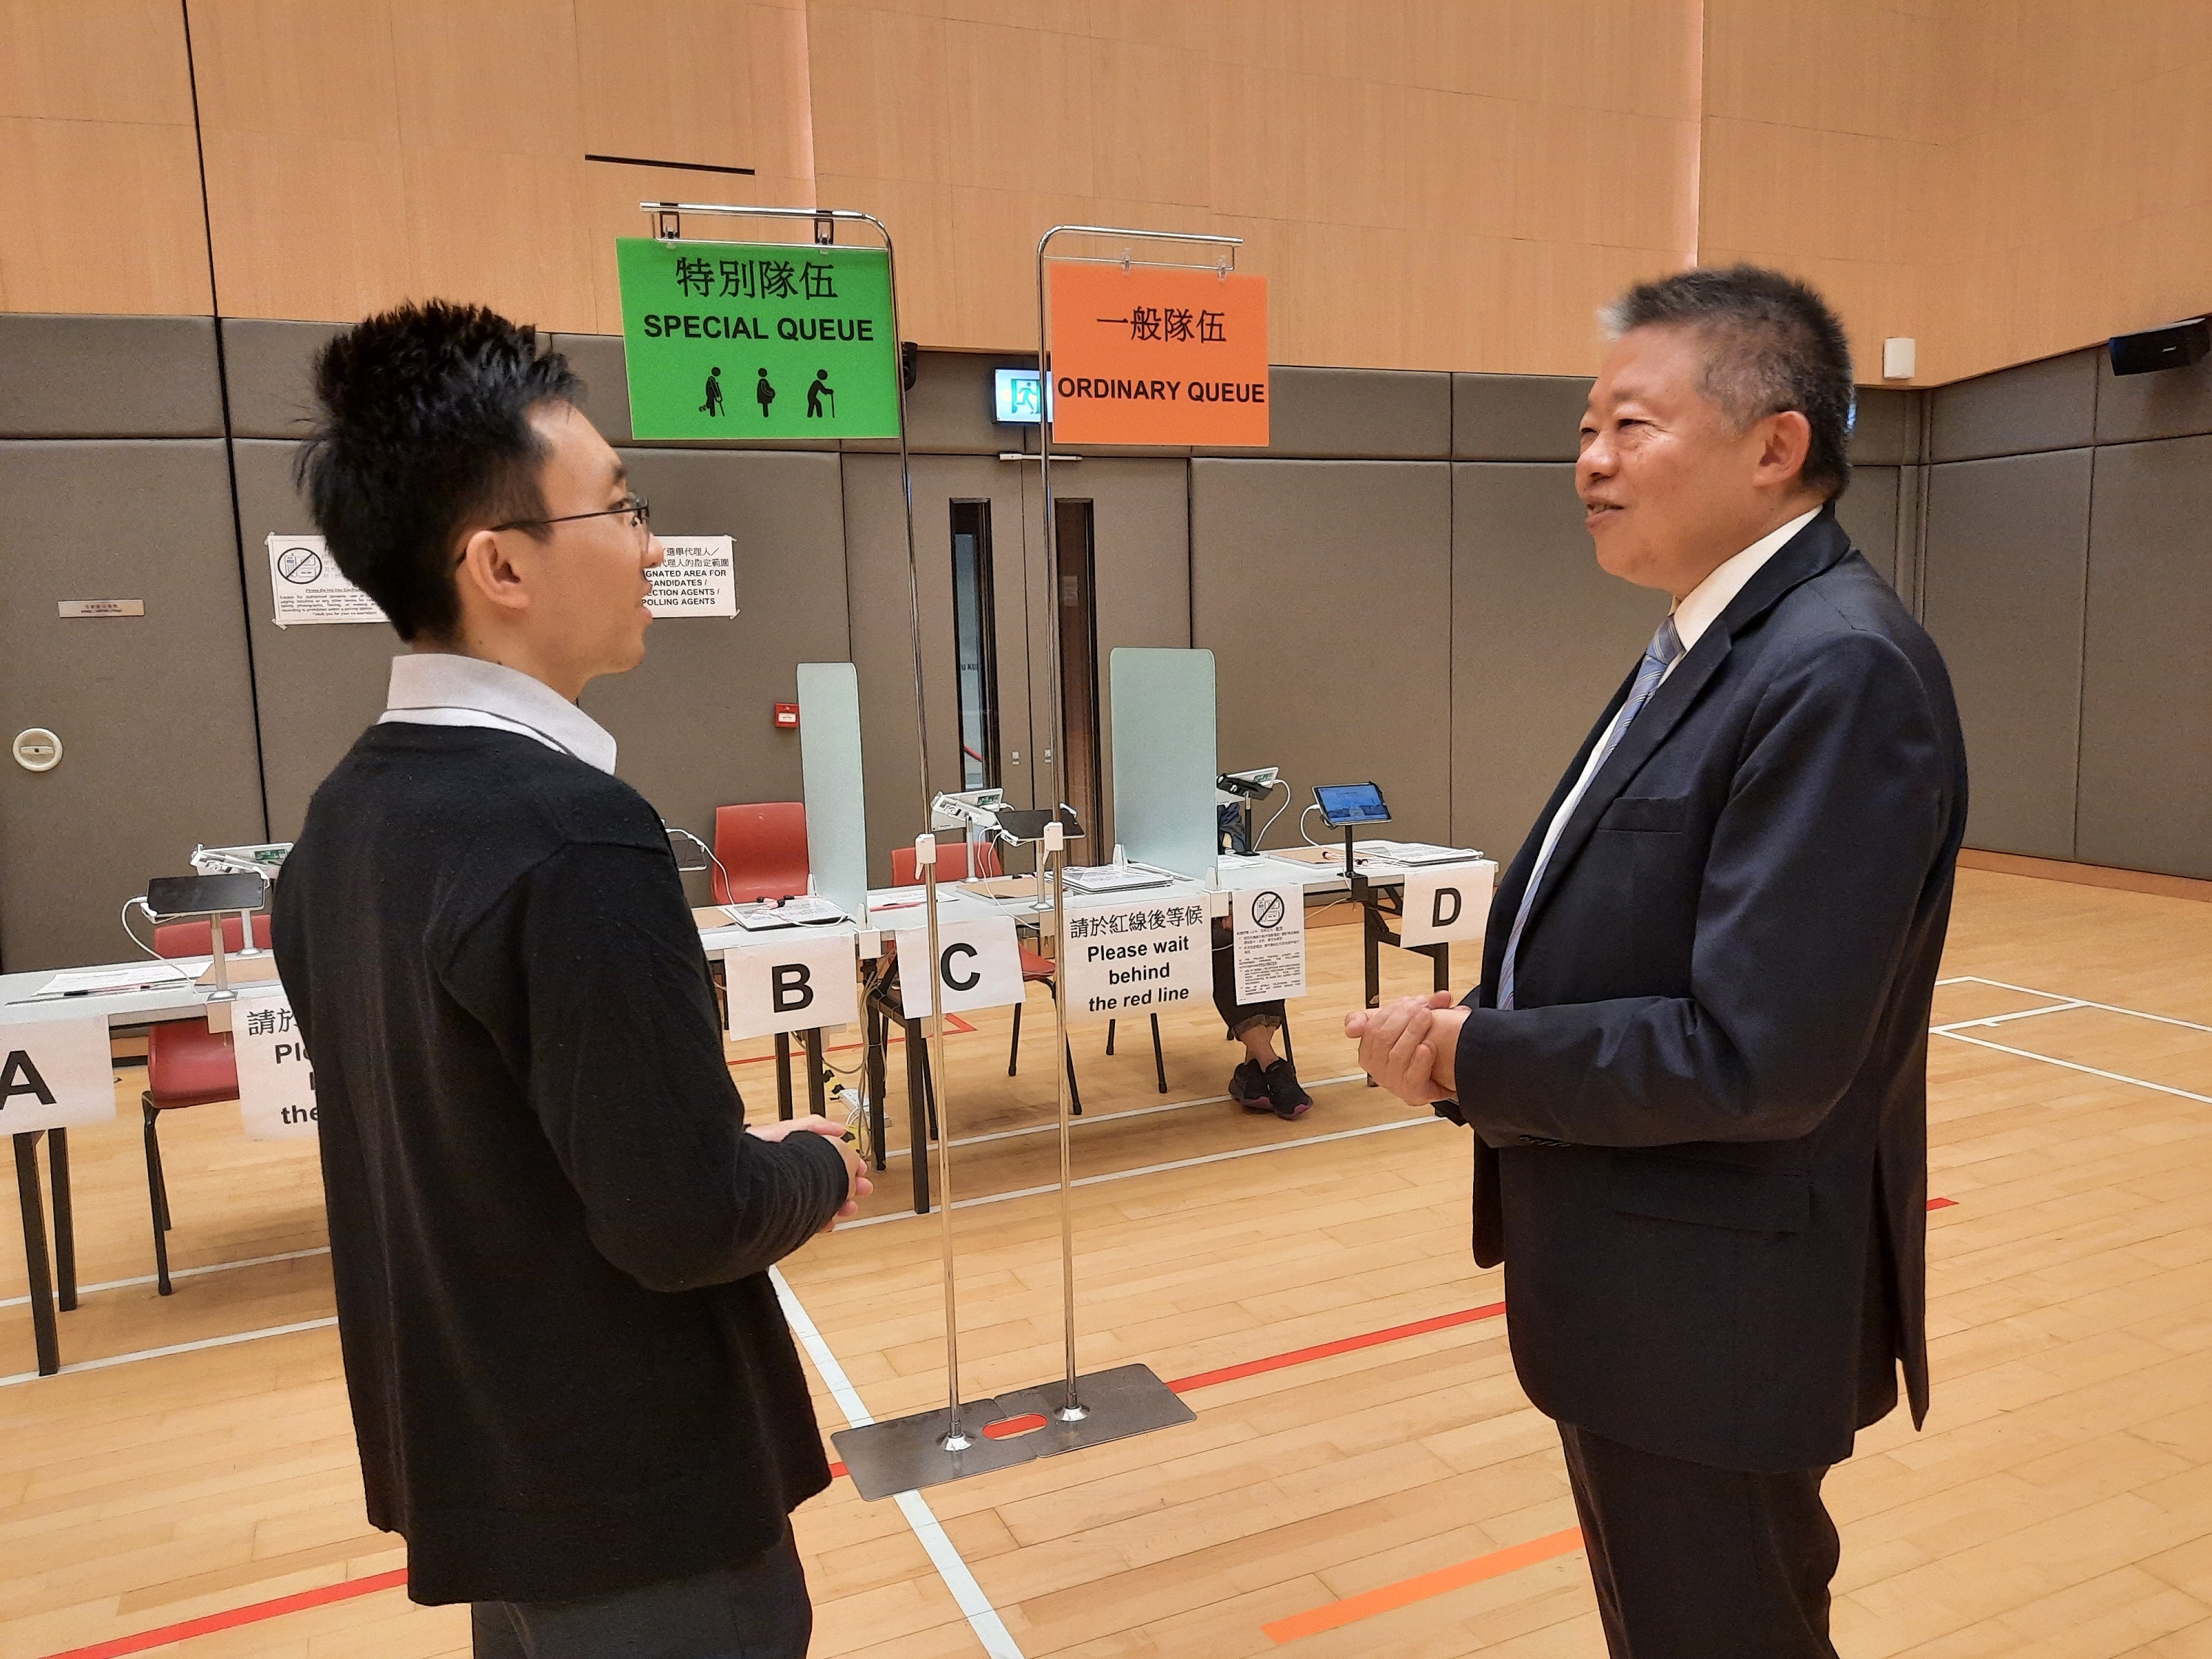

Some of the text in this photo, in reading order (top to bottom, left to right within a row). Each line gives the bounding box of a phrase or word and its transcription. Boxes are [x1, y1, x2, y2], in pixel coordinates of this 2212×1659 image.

[676, 257, 839, 300] 特別隊伍
[644, 315, 874, 342] SPECIAL QUEUE
[1096, 306, 1227, 344] 一般隊伍
[1057, 377, 1265, 404] ORDINARY QUEUE
[1069, 905, 1204, 941] 請於紅線後等候
[1432, 888, 1462, 928] D
[939, 943, 981, 992] C
[1088, 936, 1189, 964] Please wait
[771, 964, 814, 1014] B
[1109, 964, 1170, 987] behind
[1088, 984, 1189, 1013] the red line
[0, 1050, 58, 1110] A
